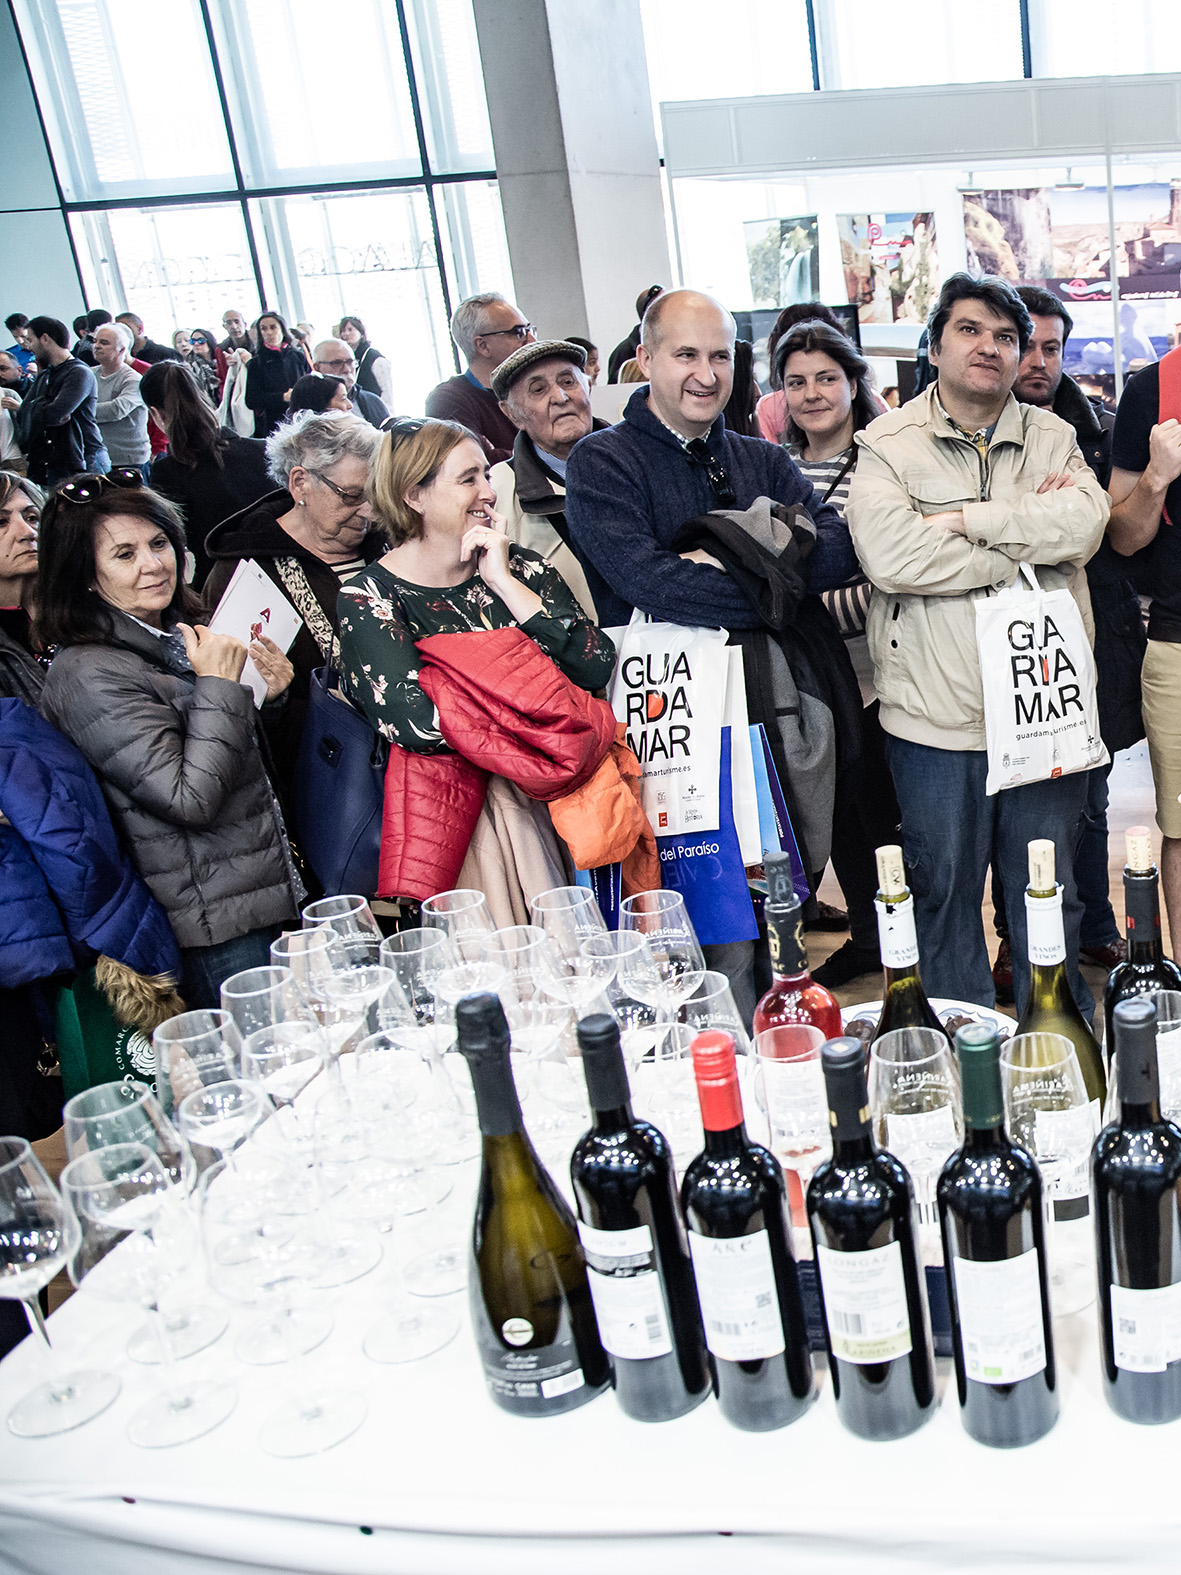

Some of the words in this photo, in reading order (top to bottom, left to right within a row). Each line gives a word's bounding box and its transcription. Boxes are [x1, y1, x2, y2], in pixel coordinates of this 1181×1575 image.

[621, 651, 693, 690] GUA
[626, 686, 693, 727] RDA
[660, 847, 676, 861] del
[678, 841, 720, 858] Paraíso
[115, 1024, 133, 1070] COMARC
